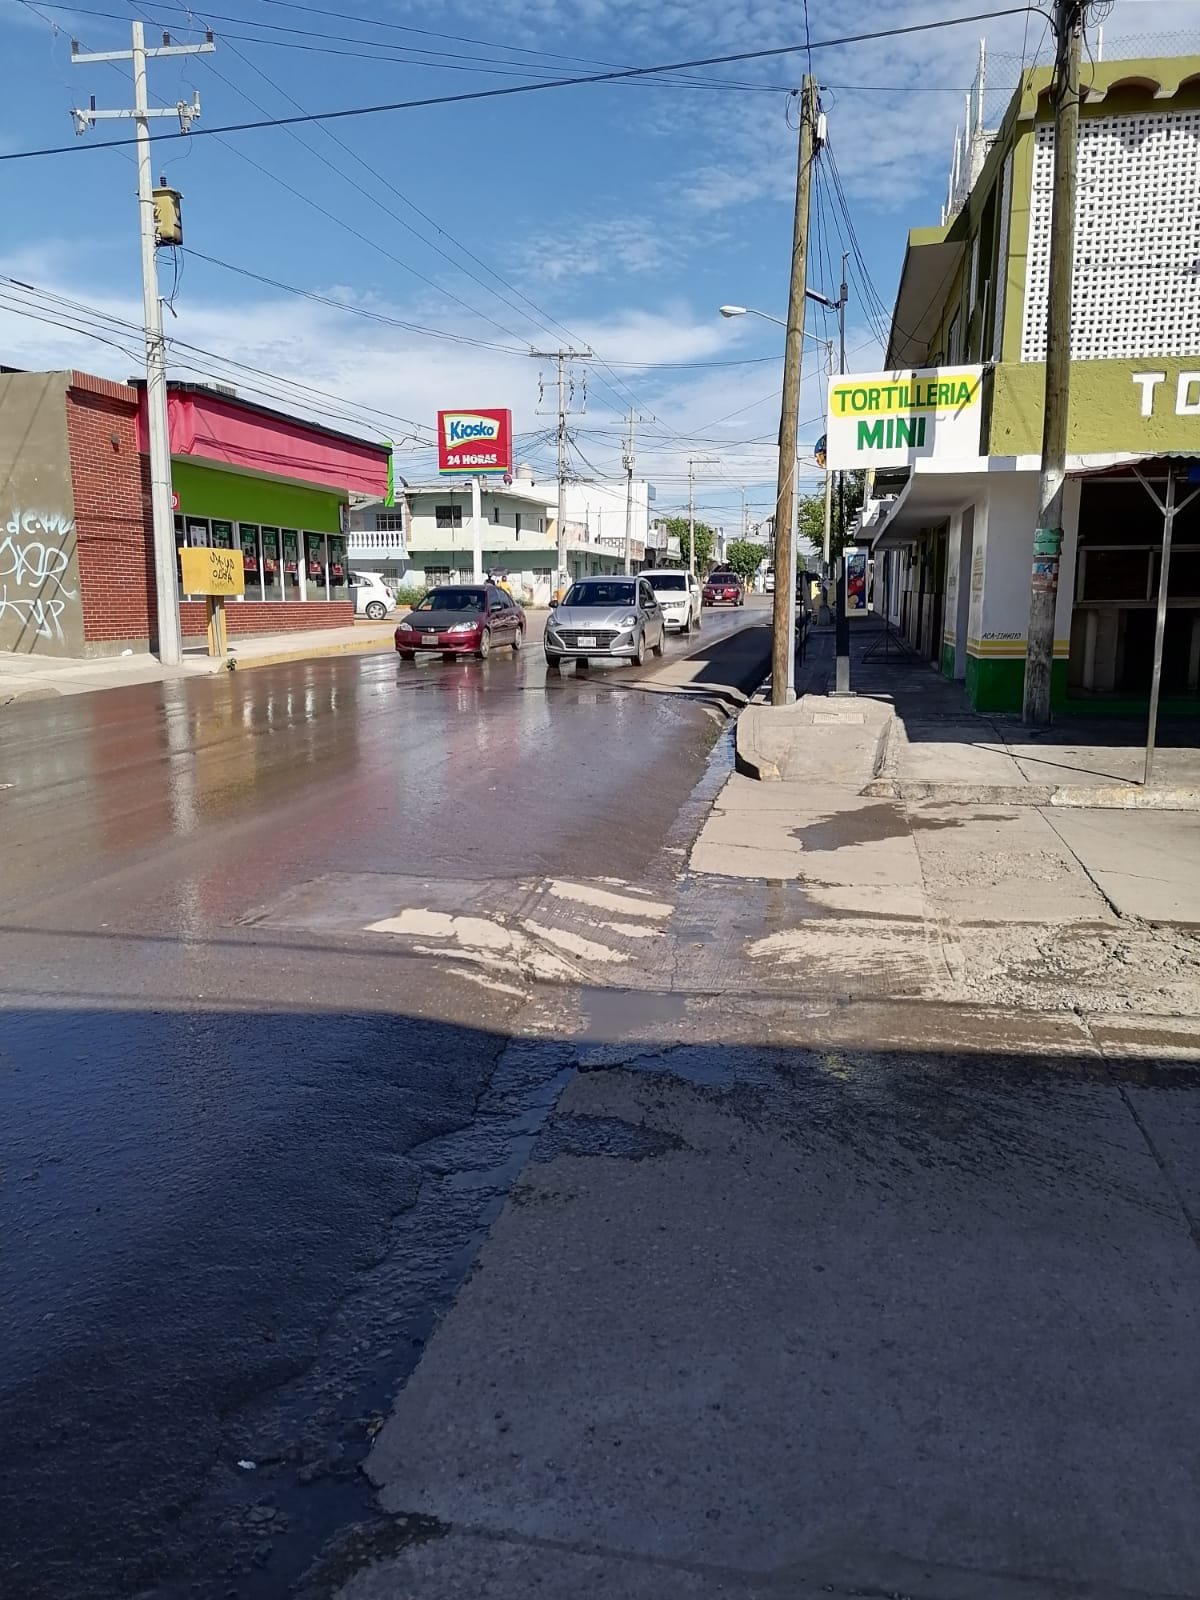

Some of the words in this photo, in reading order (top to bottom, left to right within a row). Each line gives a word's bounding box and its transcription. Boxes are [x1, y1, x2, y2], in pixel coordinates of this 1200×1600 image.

[834, 381, 971, 412] TORTILLERIA
[450, 420, 494, 441] Kiosko
[857, 416, 926, 450] MINI
[447, 454, 460, 465] 24
[462, 453, 497, 465] HORAS
